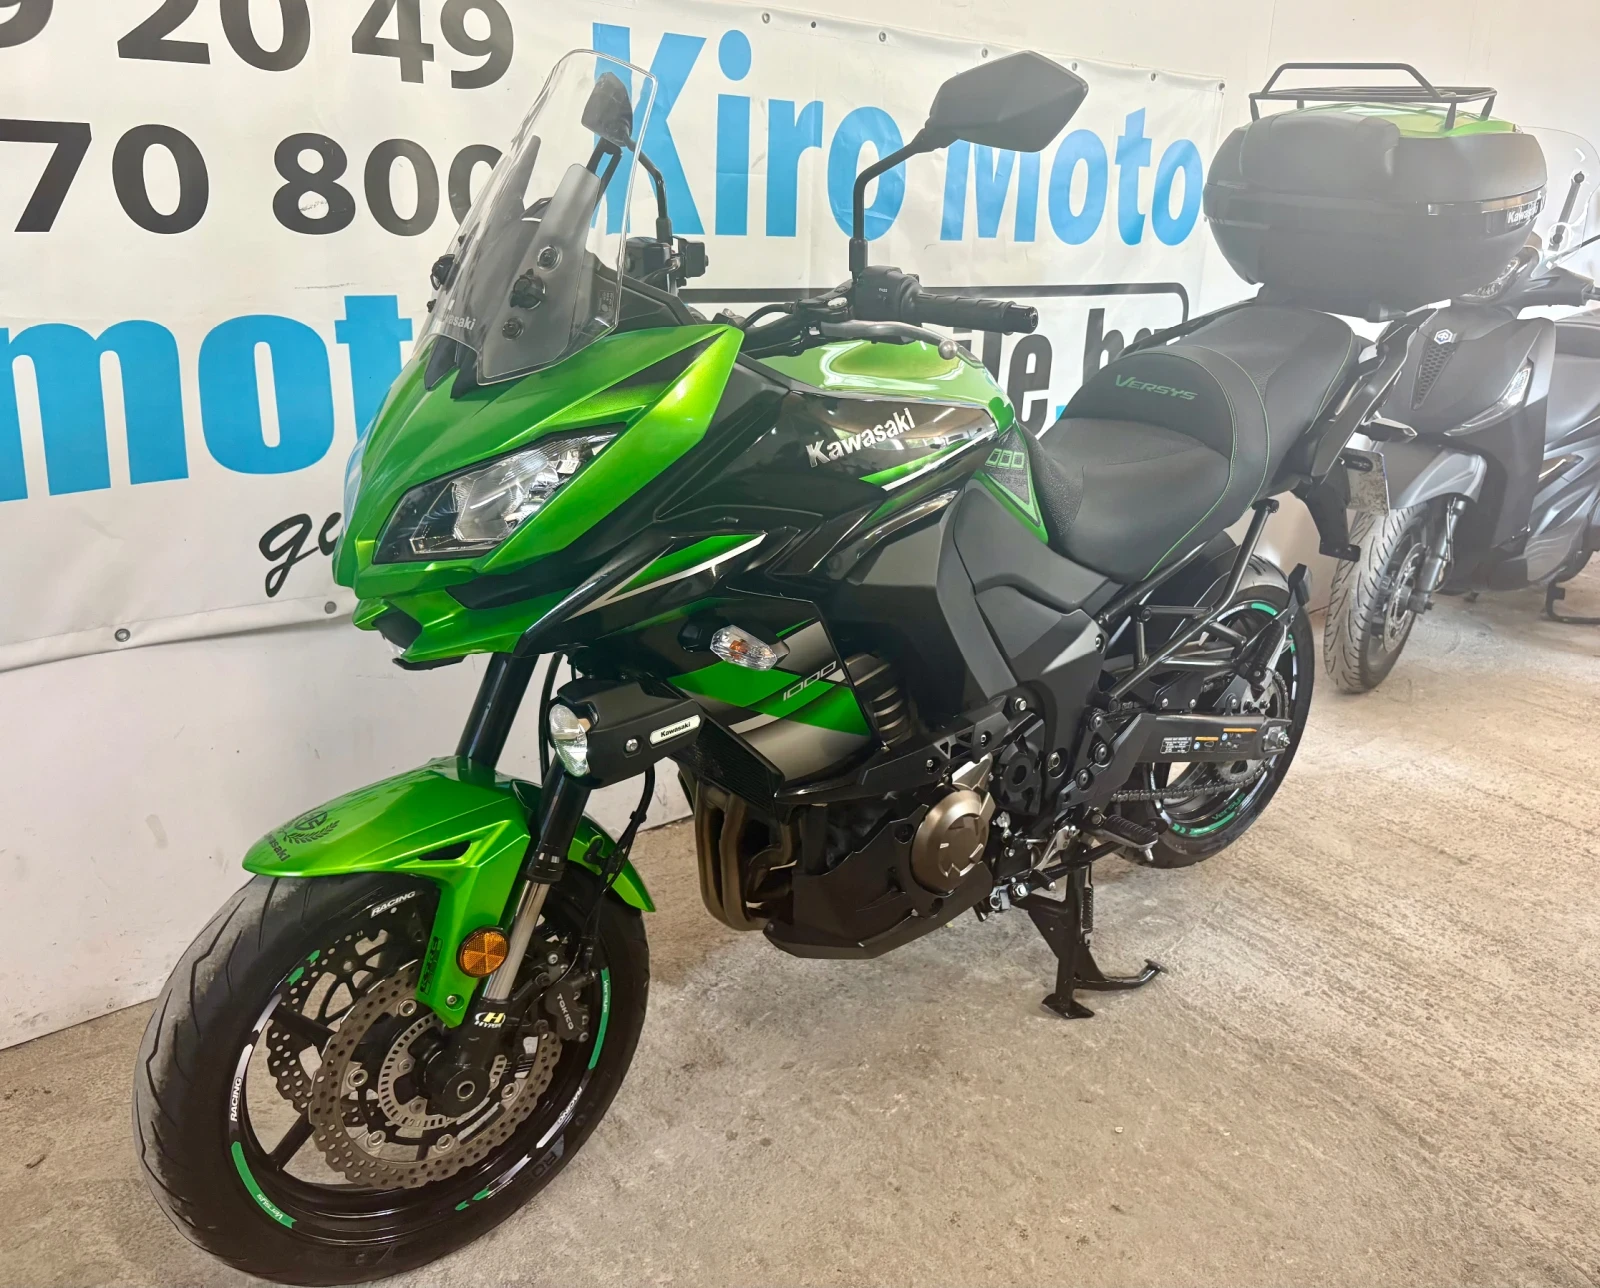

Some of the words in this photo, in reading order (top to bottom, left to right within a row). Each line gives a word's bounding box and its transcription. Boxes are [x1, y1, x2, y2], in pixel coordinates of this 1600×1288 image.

[117, 0, 310, 72] 20
[351, 0, 514, 90] 49
[592, 22, 906, 241] Kiro
[940, 107, 1203, 246] Moto
[0, 118, 209, 235] 70
[1115, 374, 1198, 400] VERSYS
[805, 407, 916, 468] Kawasaki
[782, 660, 837, 702] 1000
[660, 721, 691, 738] Kawasaki
[370, 890, 416, 919] RACING
[556, 993, 574, 1031] TOKICO
[230, 1076, 243, 1122] RACING
